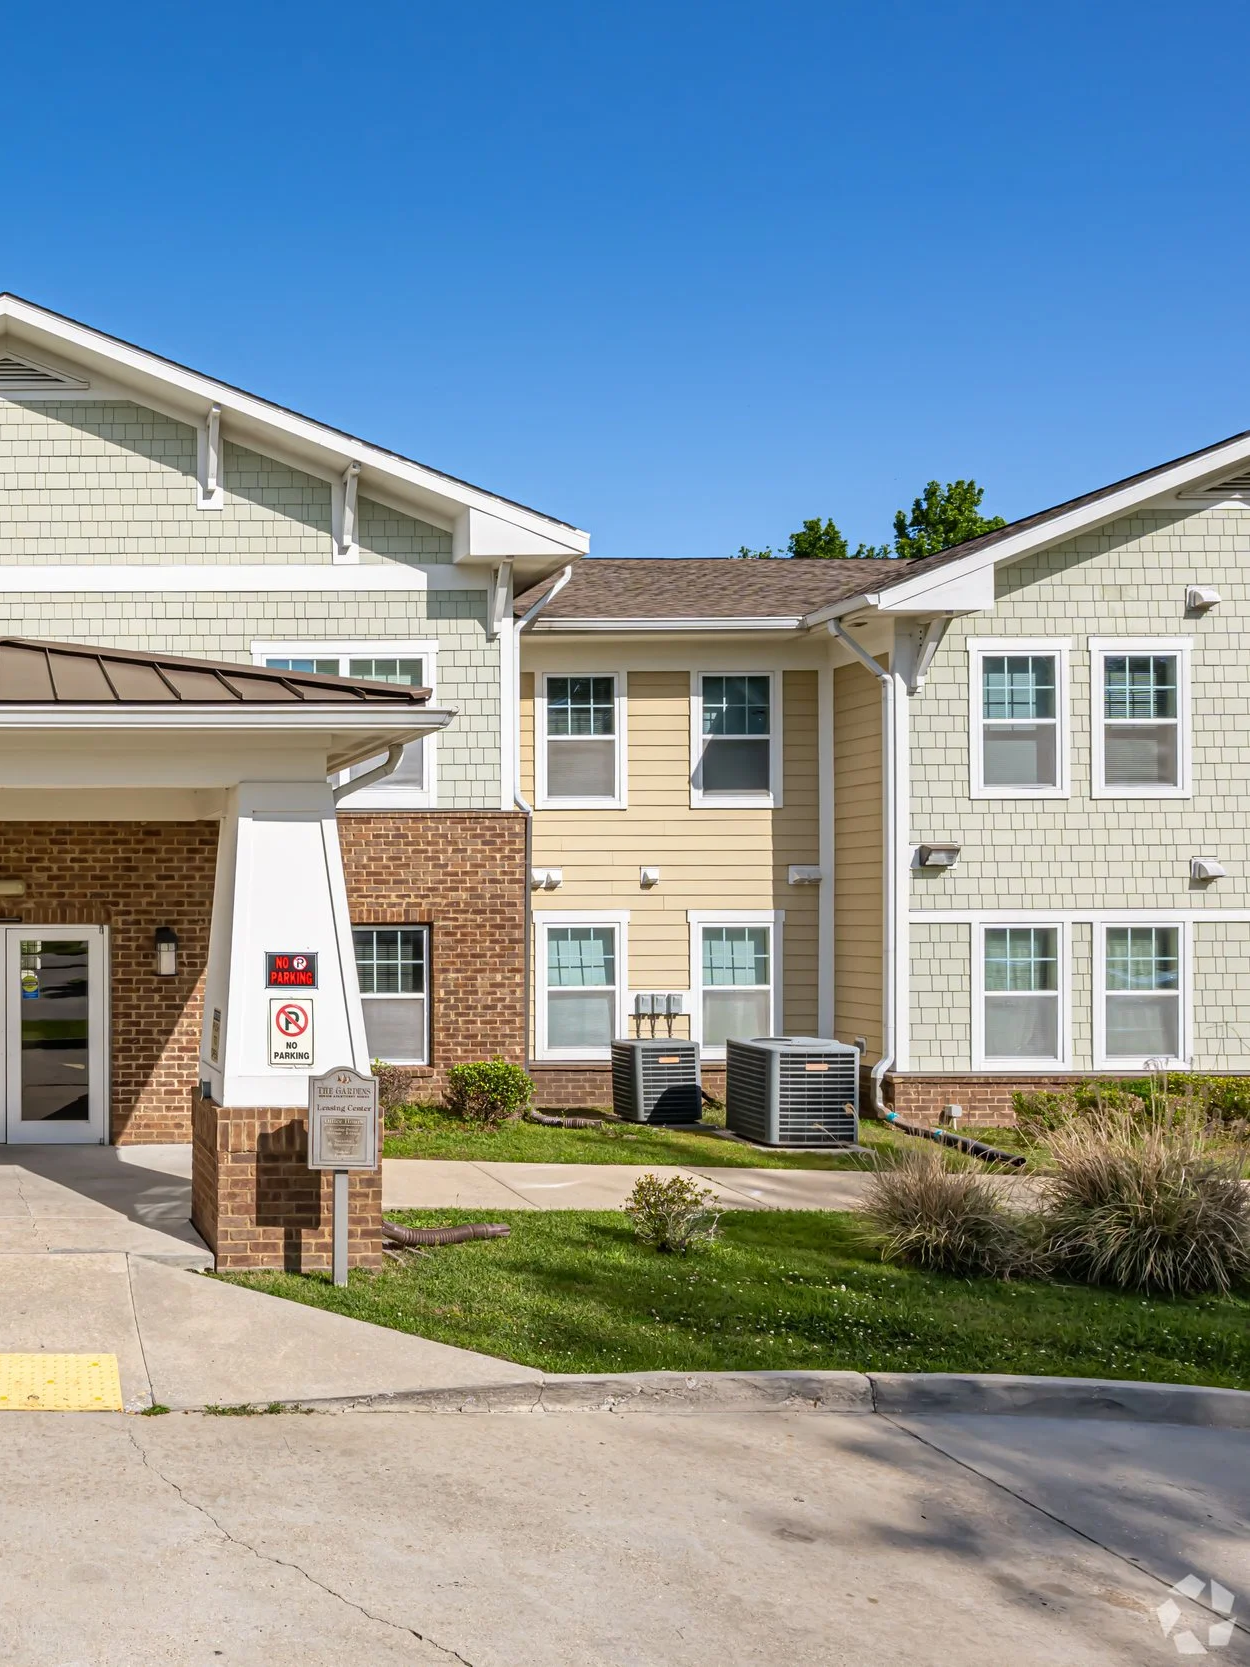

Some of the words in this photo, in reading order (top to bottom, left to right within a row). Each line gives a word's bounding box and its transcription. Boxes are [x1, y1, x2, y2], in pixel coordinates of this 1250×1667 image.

[275, 956, 289, 969] NO
[271, 971, 313, 985] PARKING
[286, 1041, 298, 1050] NO
[274, 1051, 310, 1060] PARKING
[336, 1087, 371, 1095] GARDENS
[317, 1104, 345, 1112] Leasing
